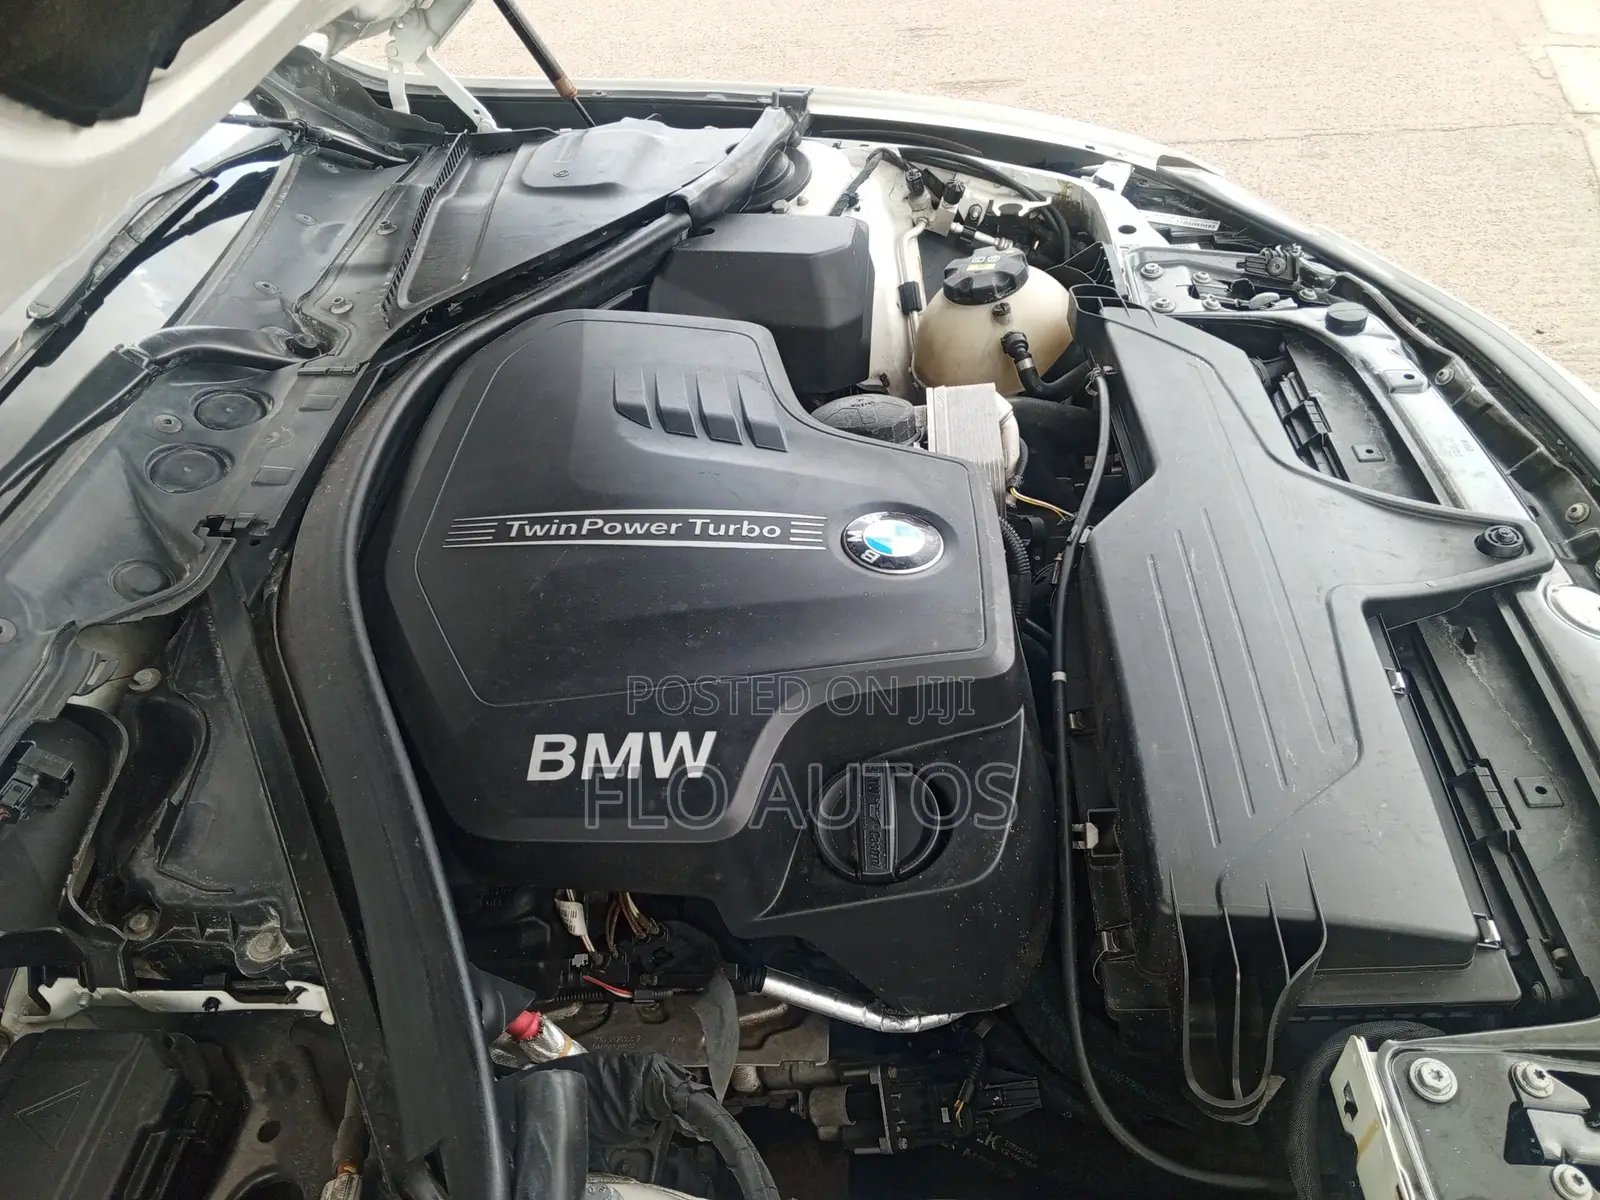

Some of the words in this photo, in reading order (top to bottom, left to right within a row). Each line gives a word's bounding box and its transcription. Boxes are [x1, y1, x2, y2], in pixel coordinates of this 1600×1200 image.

[506, 518, 683, 537] TwinPower
[688, 519, 781, 538] Turbo
[526, 731, 717, 781] BMW
